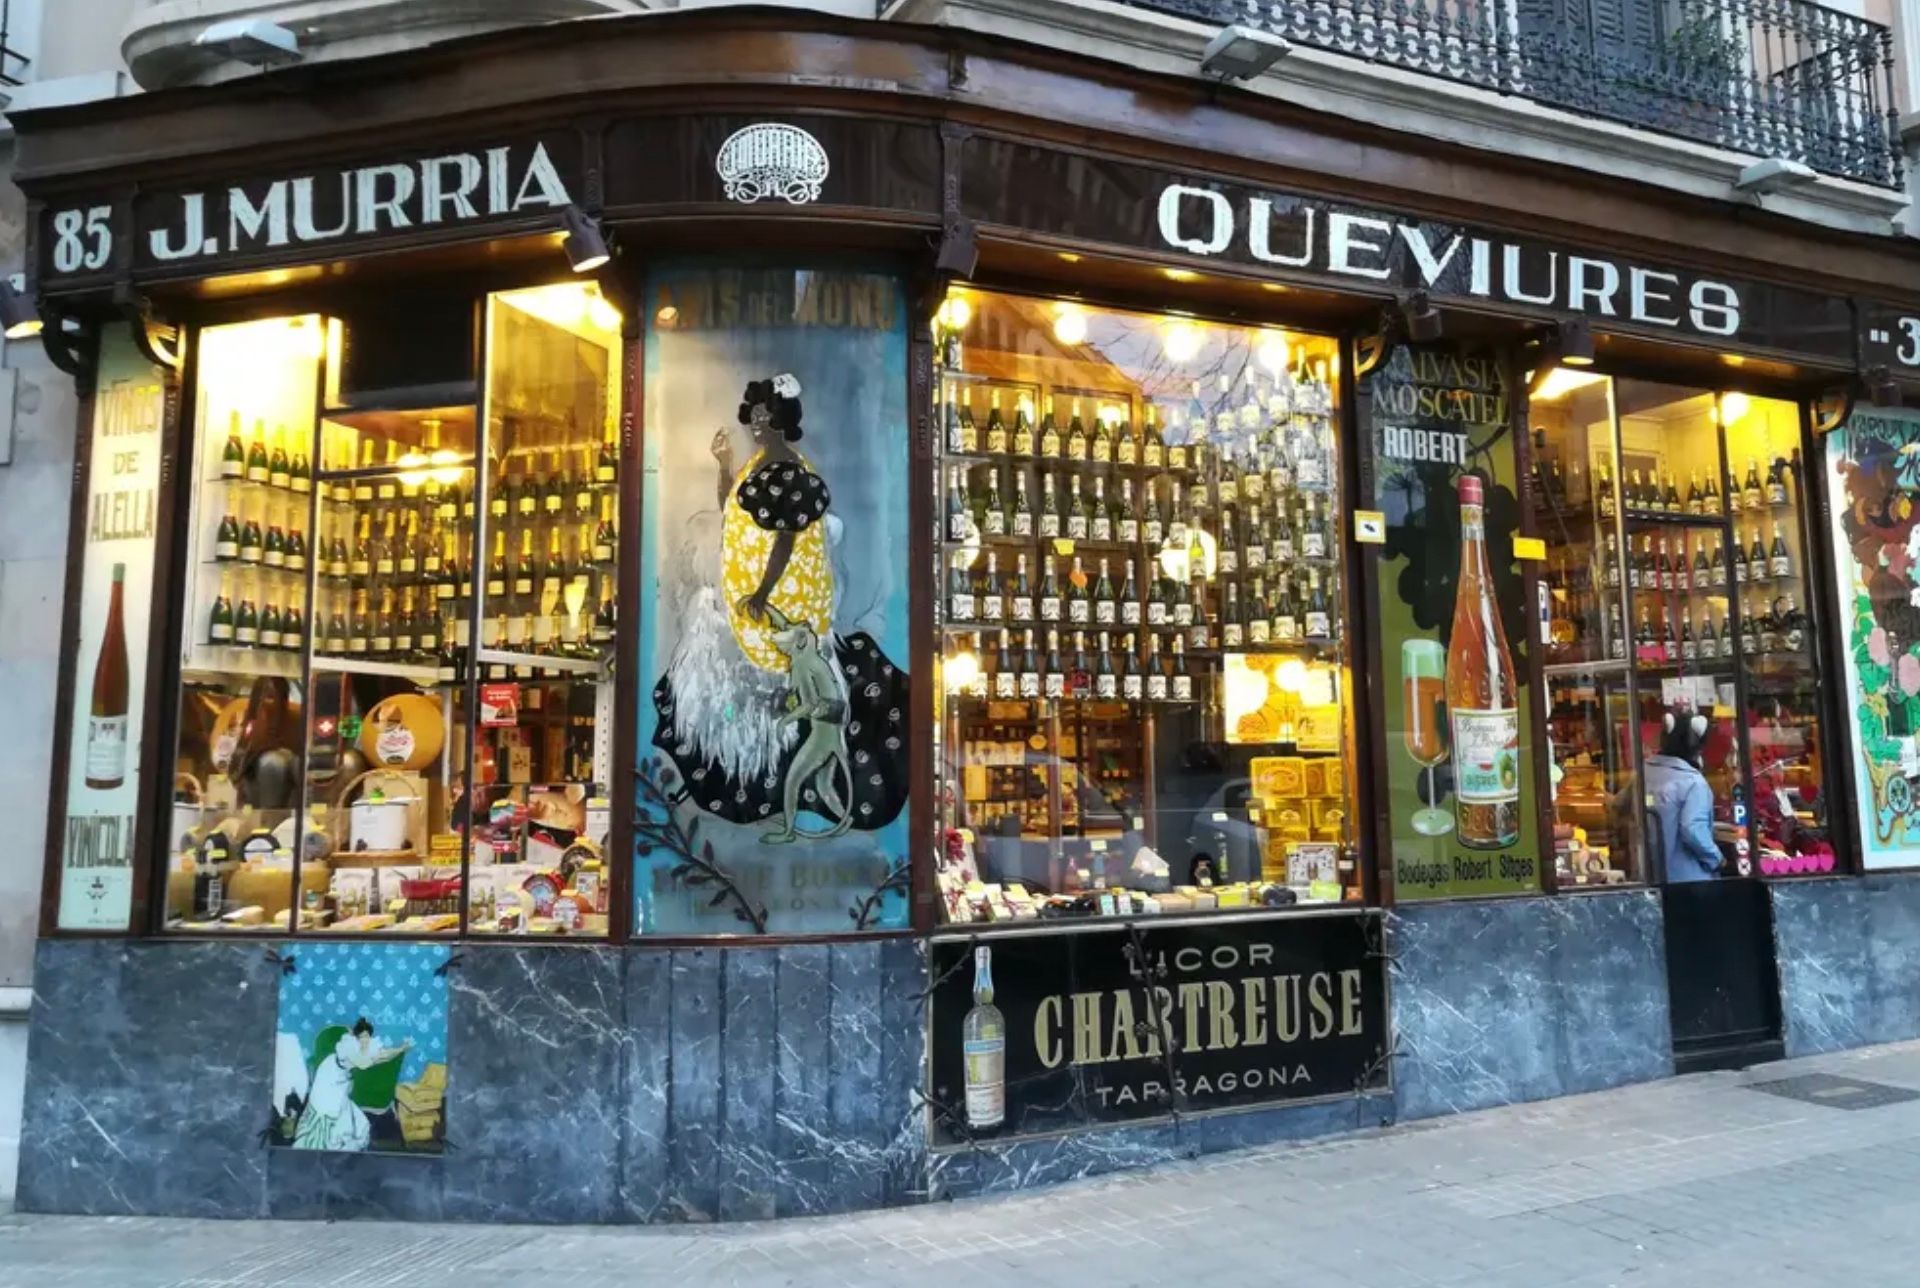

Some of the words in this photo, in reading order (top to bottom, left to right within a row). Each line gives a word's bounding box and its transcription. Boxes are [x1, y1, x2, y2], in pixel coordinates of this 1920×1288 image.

[150, 141, 572, 261] J.MURRIA
[53, 205, 112, 273] 85
[1157, 183, 1741, 336] QUEVIURES
[1371, 382, 1511, 427] MOSCATEL
[113, 451, 140, 475] DE
[1384, 425, 1469, 465] ROBERT
[1397, 858, 1450, 890] Bodegas
[1453, 855, 1493, 881] Robert
[1499, 853, 1534, 883] Sitges
[1128, 943, 1275, 975] LICOR
[1033, 968, 1364, 1069] CHARTREUSE
[1095, 1063, 1313, 1107] TARRAGONA
